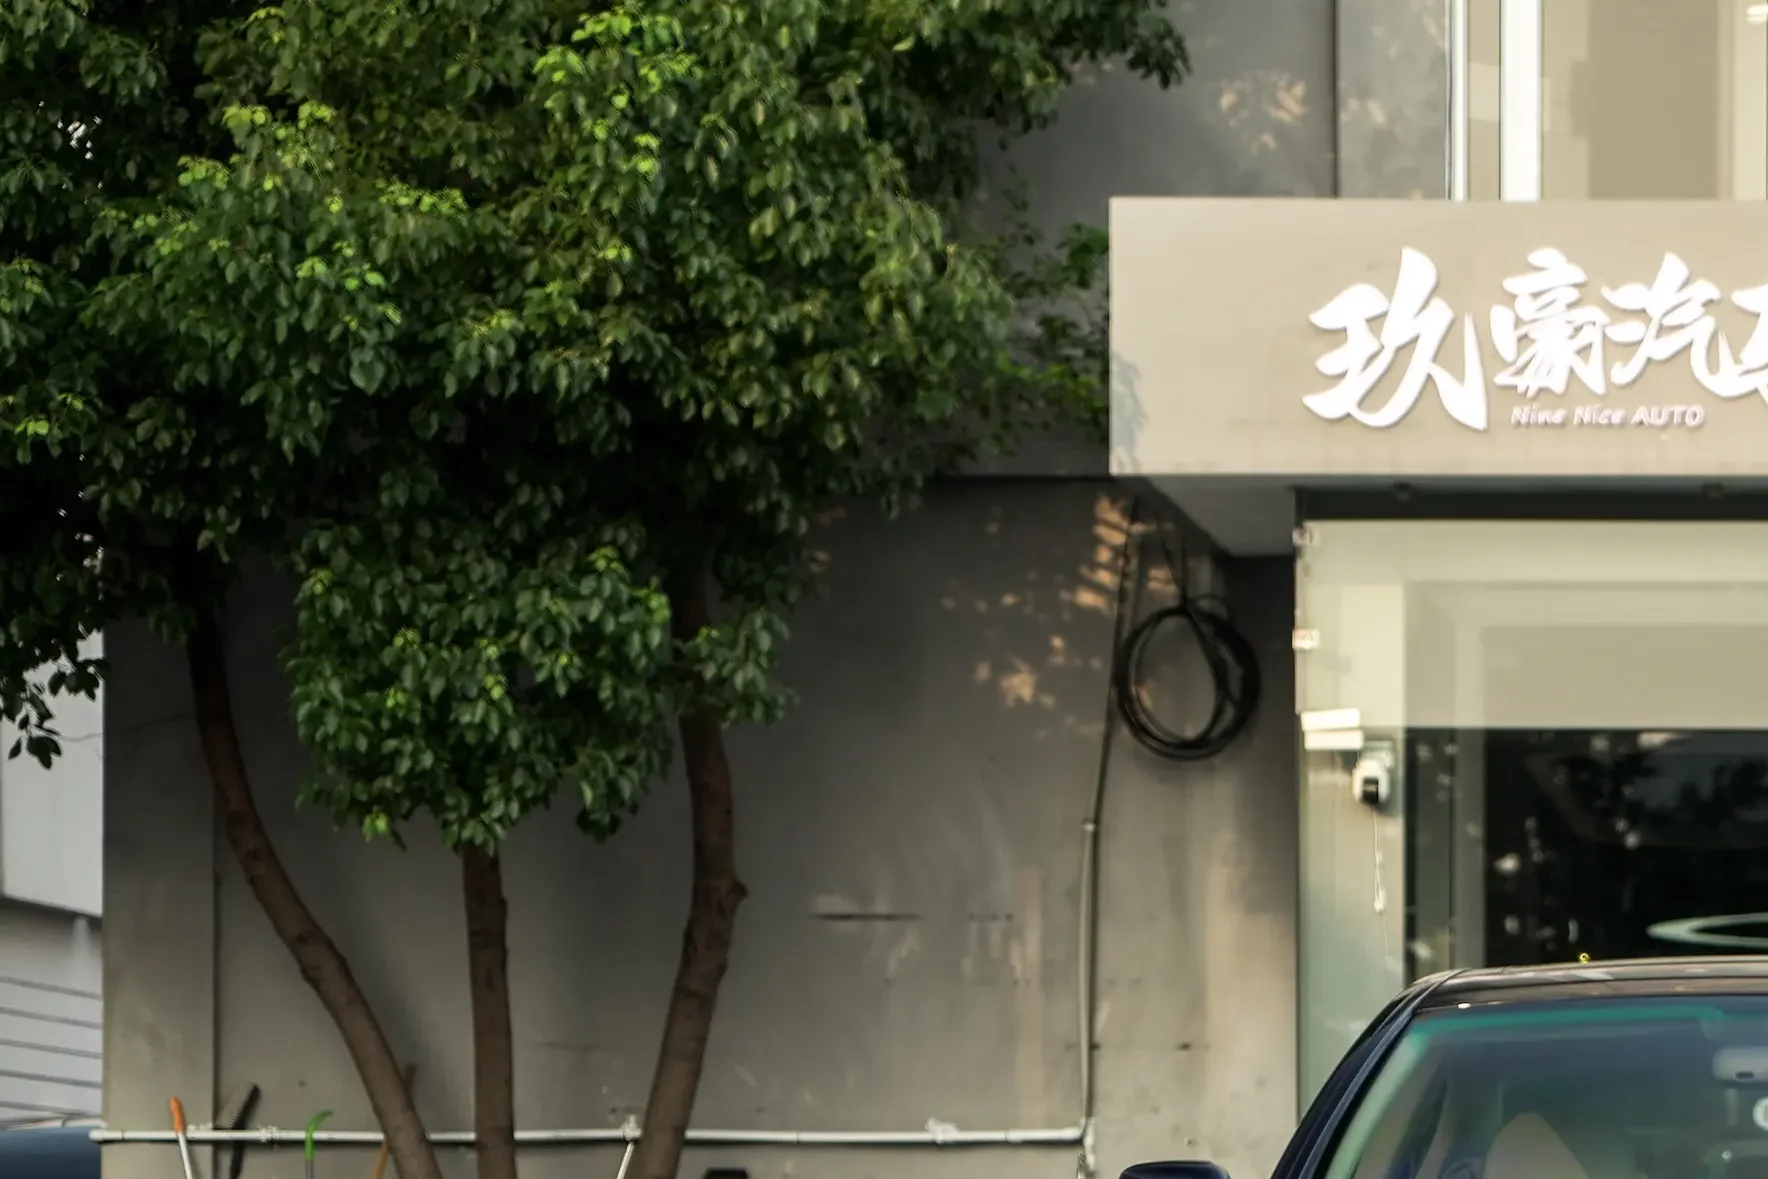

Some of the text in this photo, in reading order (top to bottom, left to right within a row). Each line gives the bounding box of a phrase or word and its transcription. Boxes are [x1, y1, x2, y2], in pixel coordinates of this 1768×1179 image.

[1511, 404, 1705, 427] Nine Nice AUTO
